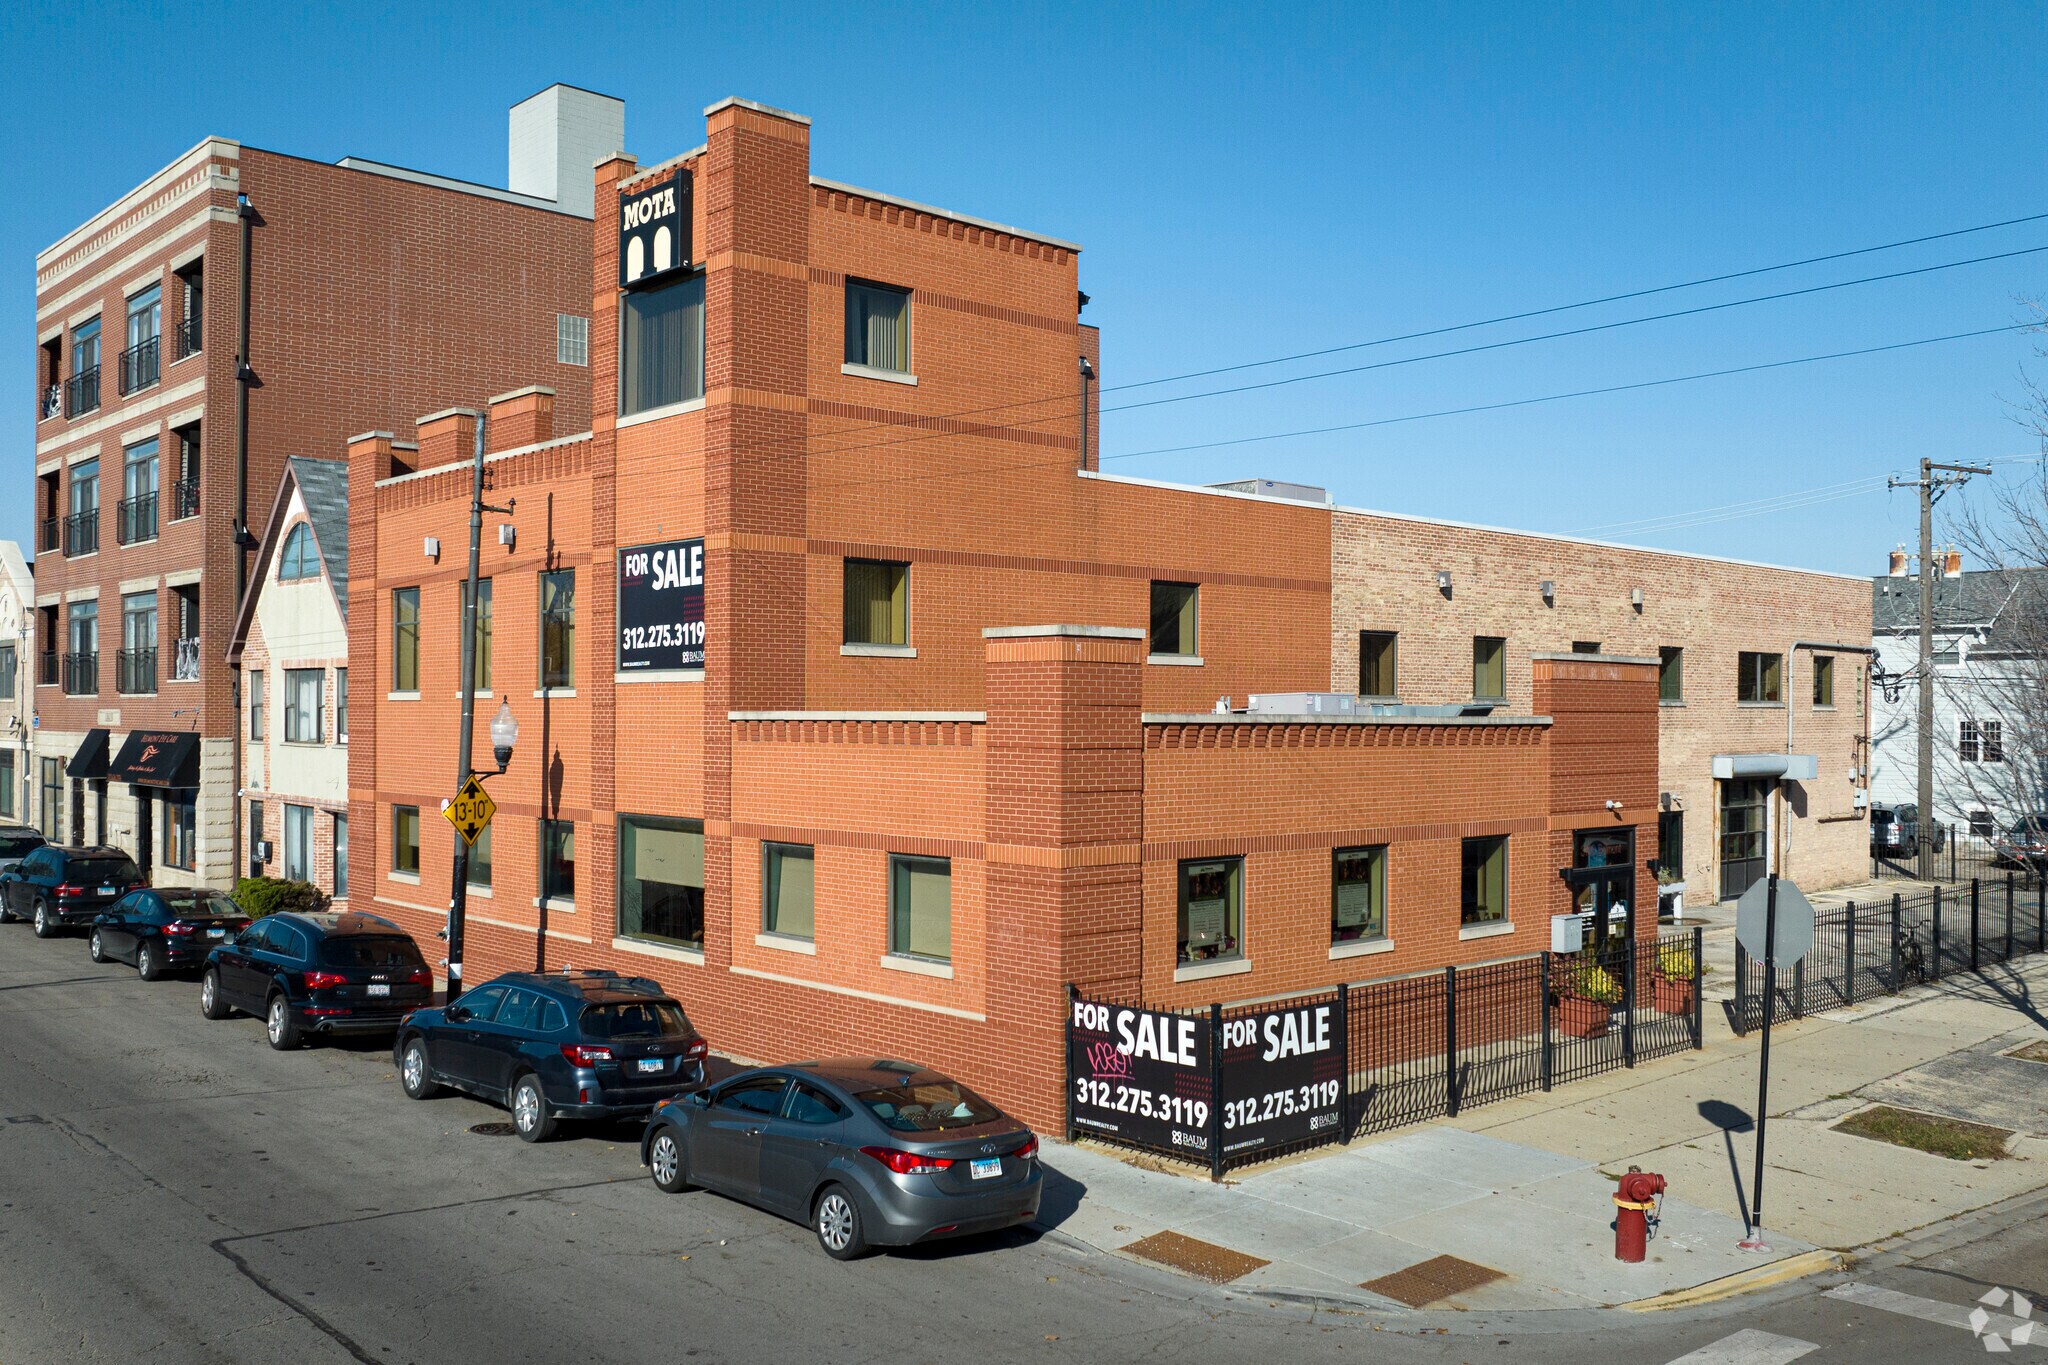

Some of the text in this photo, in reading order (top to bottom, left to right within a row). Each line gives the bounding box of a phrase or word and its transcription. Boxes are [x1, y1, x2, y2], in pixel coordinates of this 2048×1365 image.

[623, 187, 675, 231] MOTA
[625, 546, 702, 590] FOR SALE
[622, 621, 705, 650] 312.275.3119
[1074, 1002, 1109, 1032] FOR
[1116, 1010, 1196, 1067] SALE
[1223, 1007, 1330, 1062] FOR SALE
[1076, 1078, 1208, 1128] 312.275.3119
[1224, 1079, 1339, 1129] 312.275.3119
[1319, 1112, 1338, 1124] BAUM
[1183, 1133, 1208, 1147] BAUM
